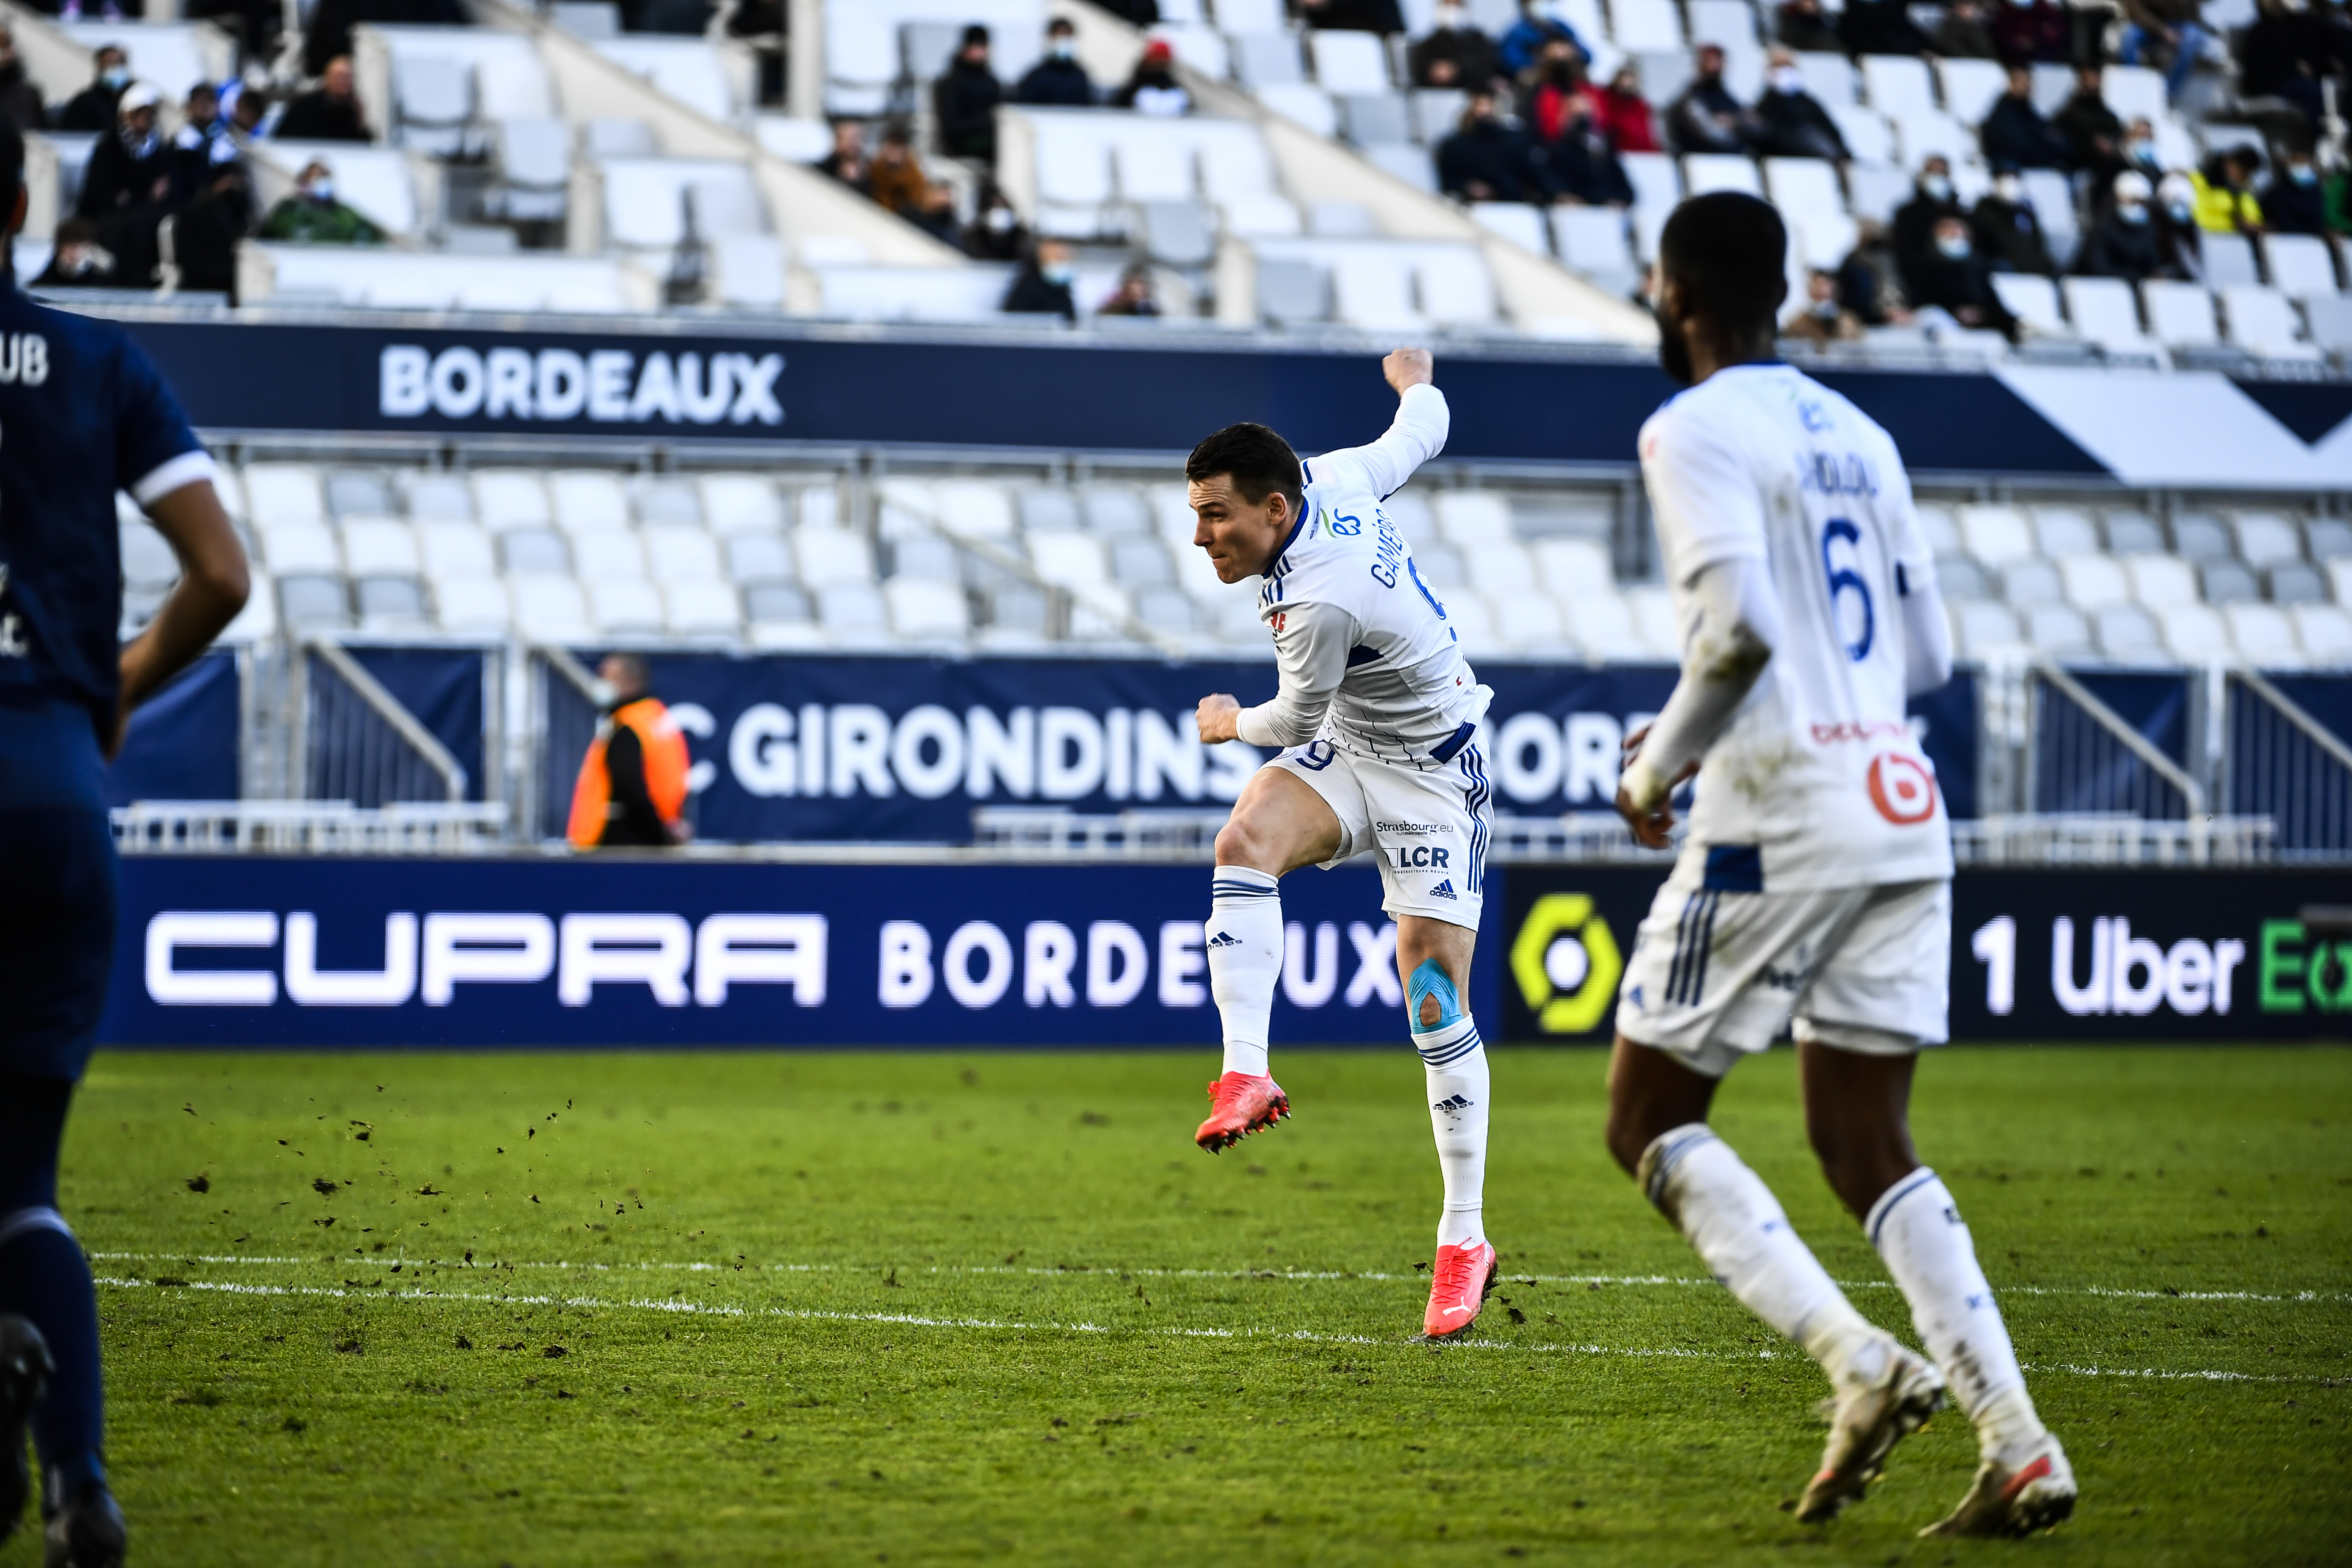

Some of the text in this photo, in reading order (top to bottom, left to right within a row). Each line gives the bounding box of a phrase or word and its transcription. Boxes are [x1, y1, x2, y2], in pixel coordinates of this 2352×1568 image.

[379, 345, 785, 424] BORDEAUX
[1821, 519, 1875, 662] 6
[727, 702, 1264, 804] GIRONDINS
[1376, 820, 1453, 836] Strasbourg.eu
[1400, 846, 1449, 868] LCR
[1429, 890, 1457, 901] adidas
[145, 910, 829, 1007] CUPRA
[877, 919, 1401, 1009] BORDEUX
[1972, 914, 2016, 1015] 1
[2050, 914, 2245, 1015] Uber
